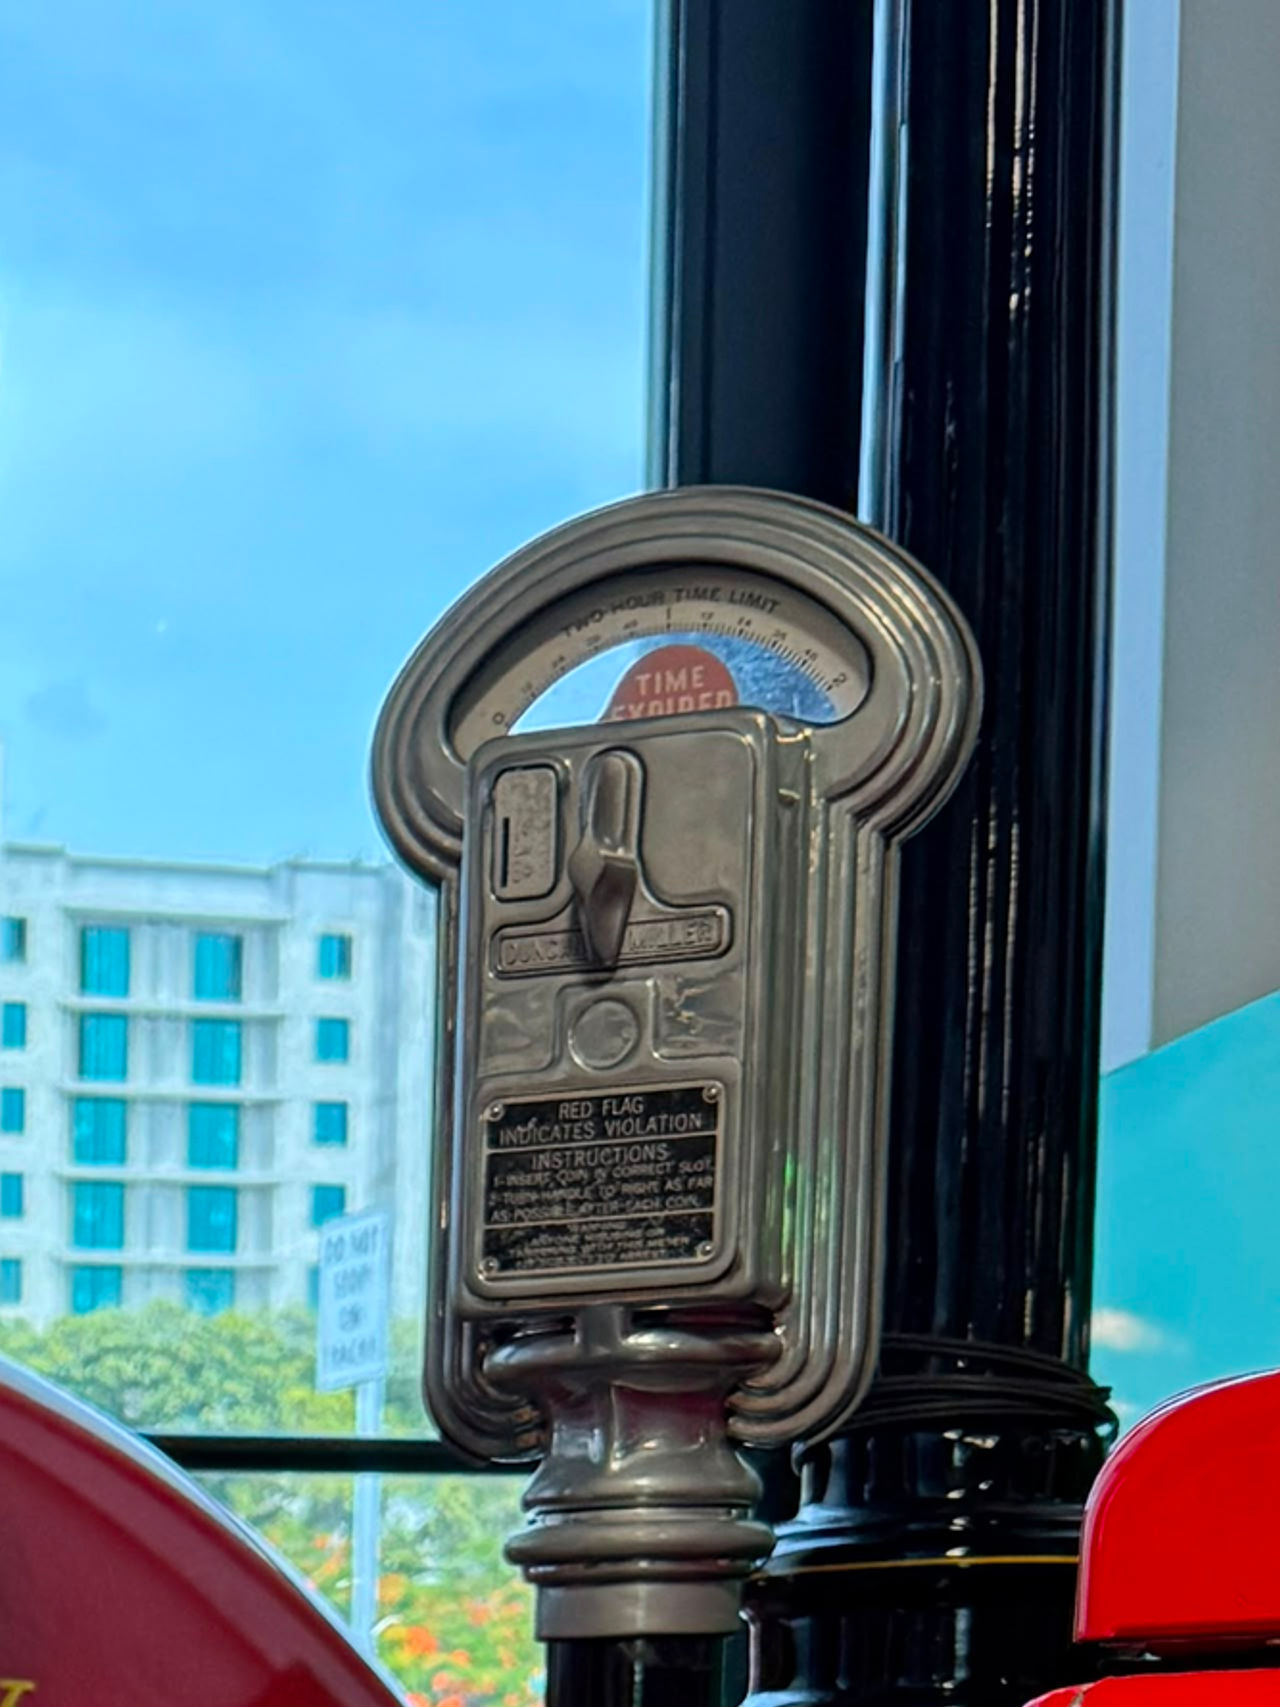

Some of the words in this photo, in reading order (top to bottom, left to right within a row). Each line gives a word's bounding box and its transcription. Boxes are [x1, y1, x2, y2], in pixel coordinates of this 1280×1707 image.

[675, 587, 722, 603] TIME
[729, 588, 782, 615] LIMIT
[635, 664, 705, 696] TIME
[559, 1101, 593, 1119] RED
[602, 1097, 644, 1116] FLAG
[499, 1121, 595, 1146] INDICATES
[605, 1113, 703, 1137] VIOLATION
[531, 1142, 670, 1170] INSTRUCTIONS
[664, 1176, 683, 1192] AS
[686, 1174, 714, 1190] FAR
